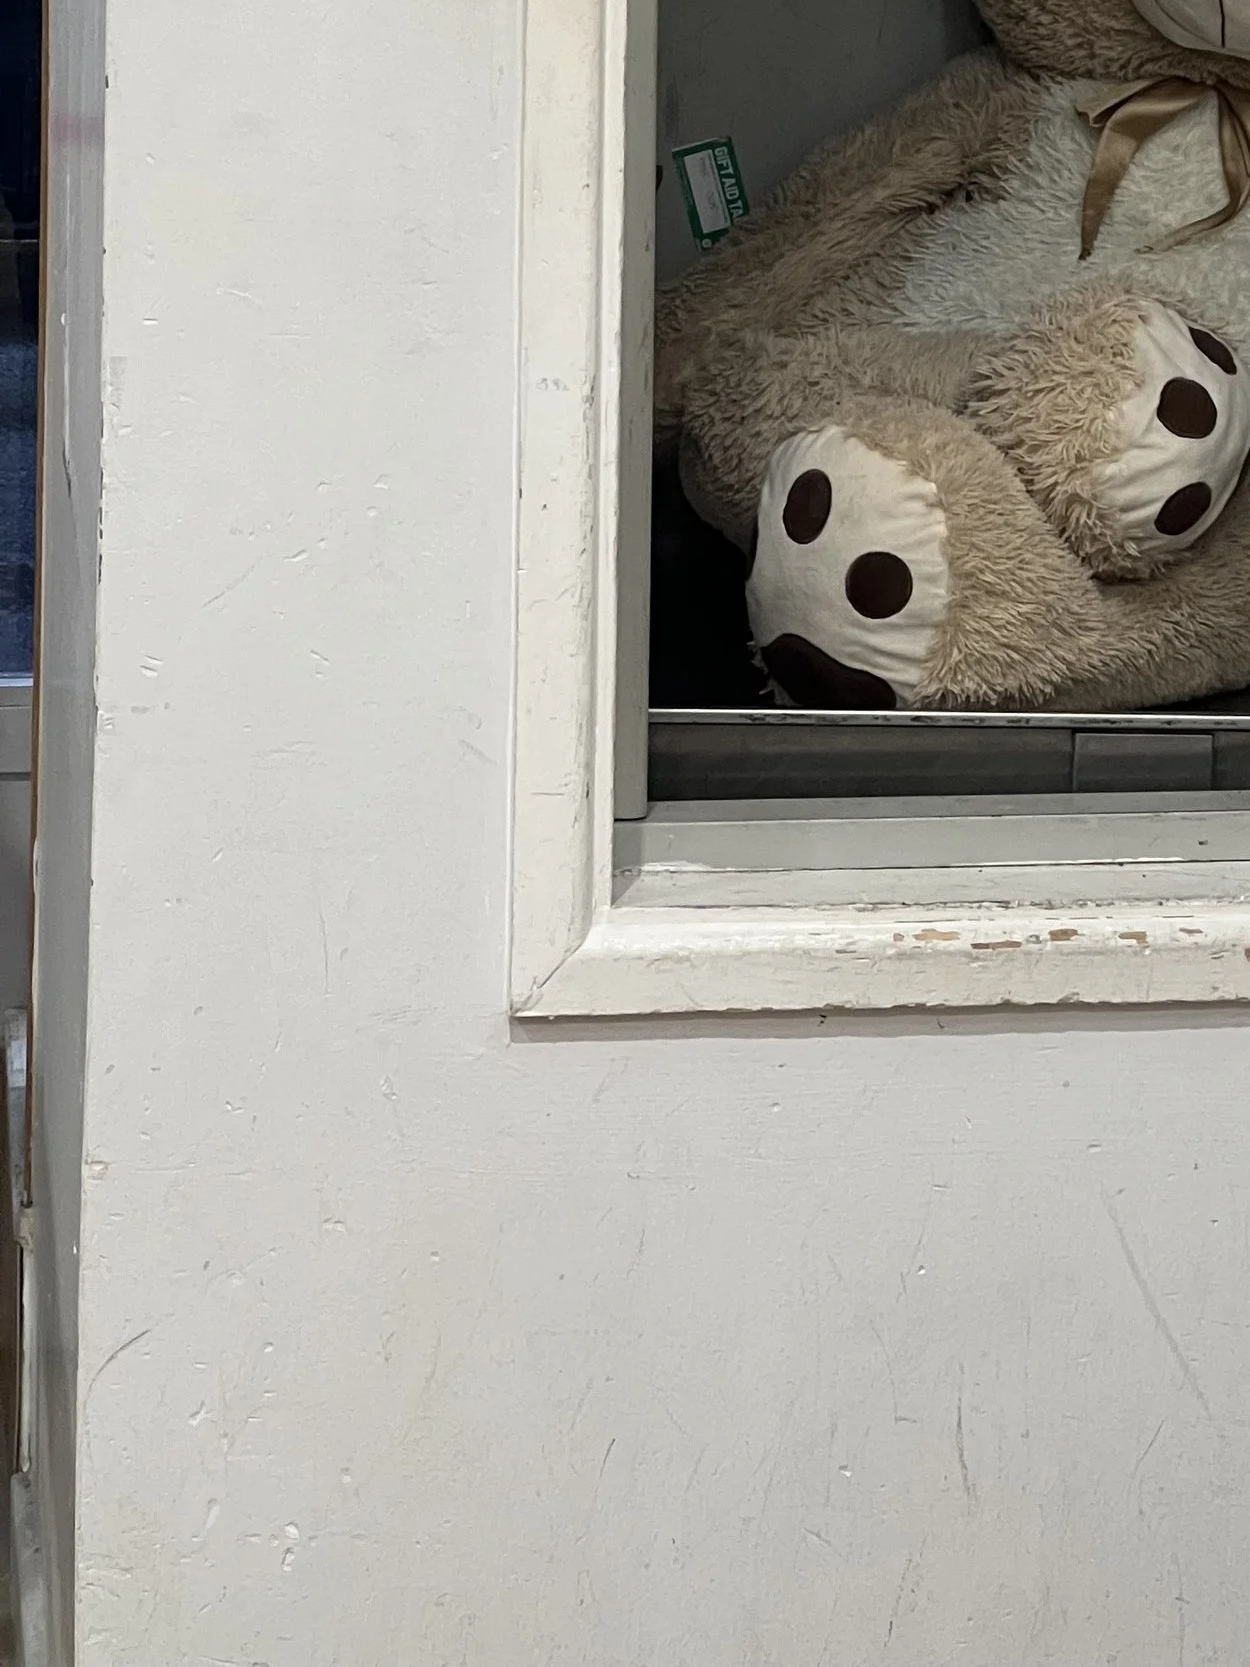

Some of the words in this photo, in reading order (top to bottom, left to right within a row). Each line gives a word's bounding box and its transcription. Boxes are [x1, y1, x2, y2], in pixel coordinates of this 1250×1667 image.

[714, 146, 734, 175] GIFT
[721, 177, 740, 200] AID
[727, 199, 745, 222] TA
